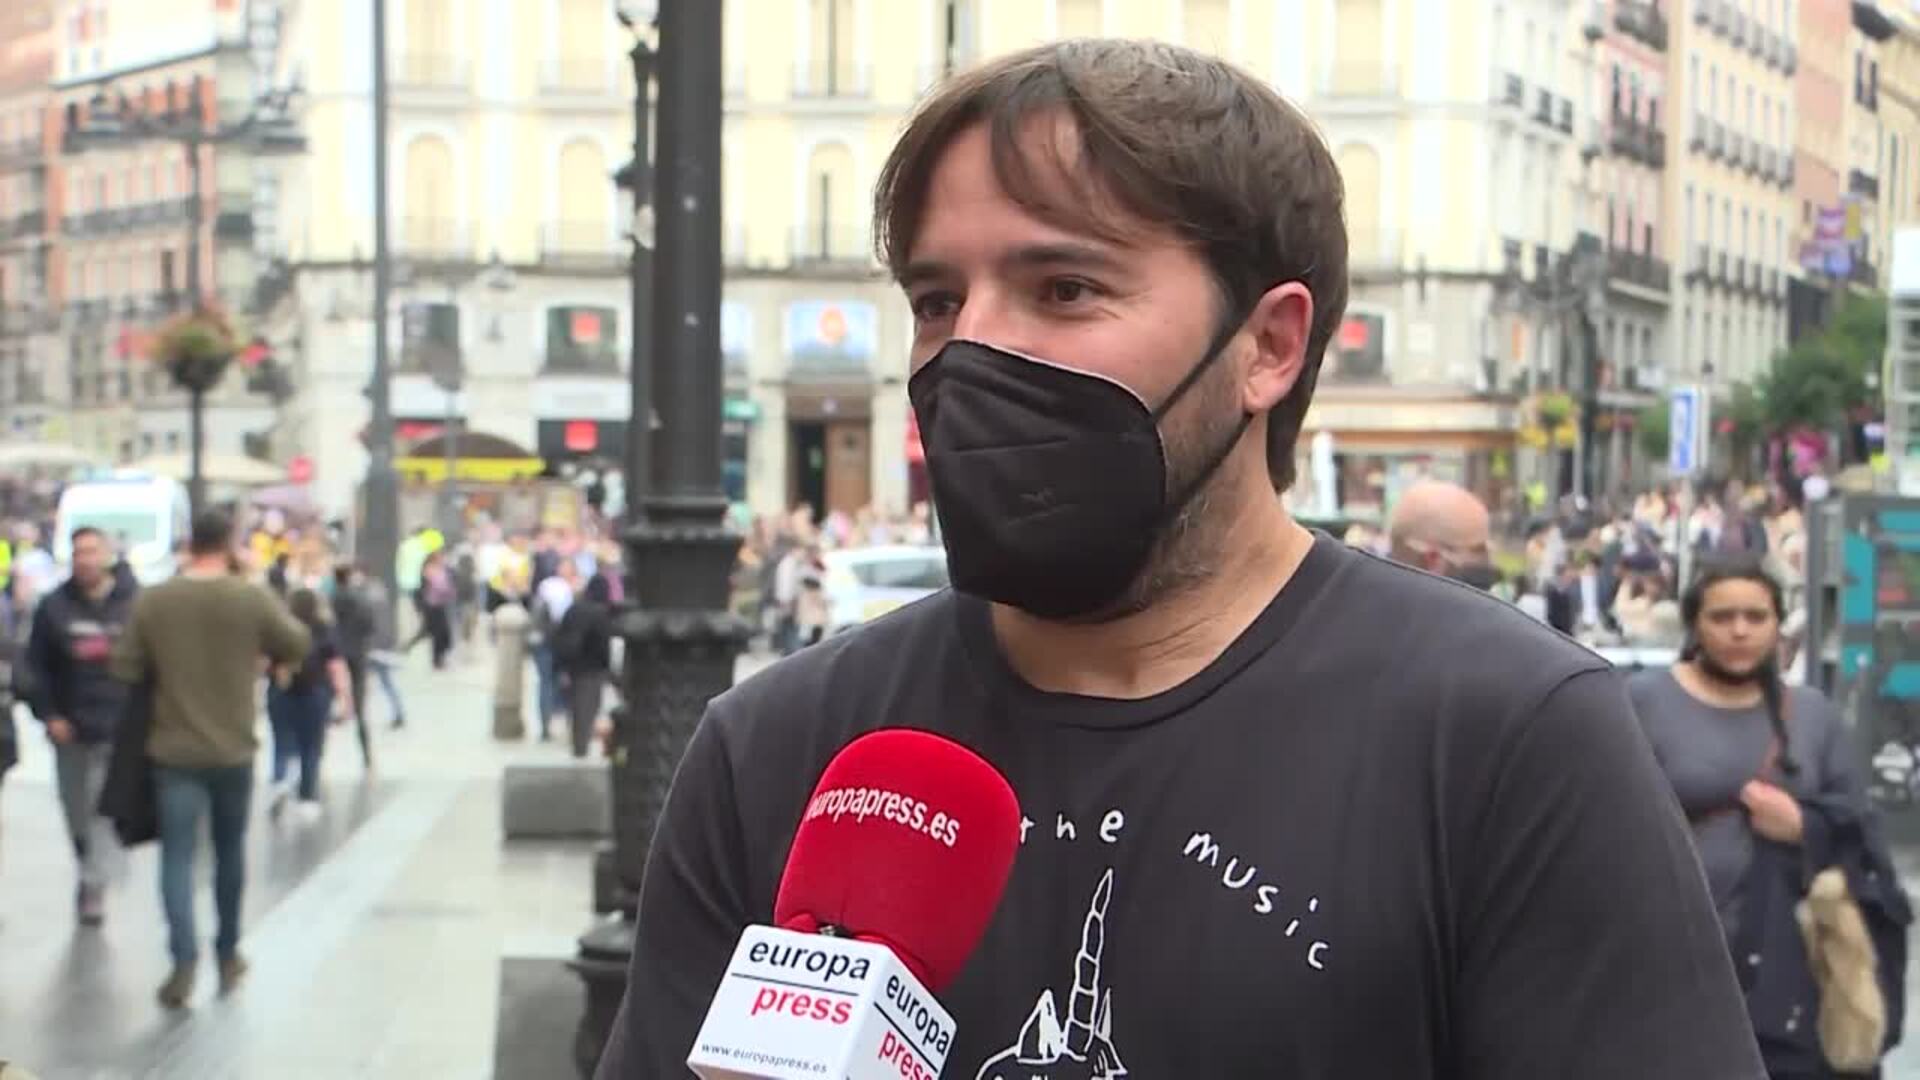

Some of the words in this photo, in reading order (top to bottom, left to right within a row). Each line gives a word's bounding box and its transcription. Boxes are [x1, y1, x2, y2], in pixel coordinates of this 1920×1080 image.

[1183, 831, 1329, 970] music
[748, 941, 871, 982] europa
[750, 986, 853, 1025] press
[885, 973, 950, 1057] europa
[701, 1043, 828, 1074] www.europapress.es
